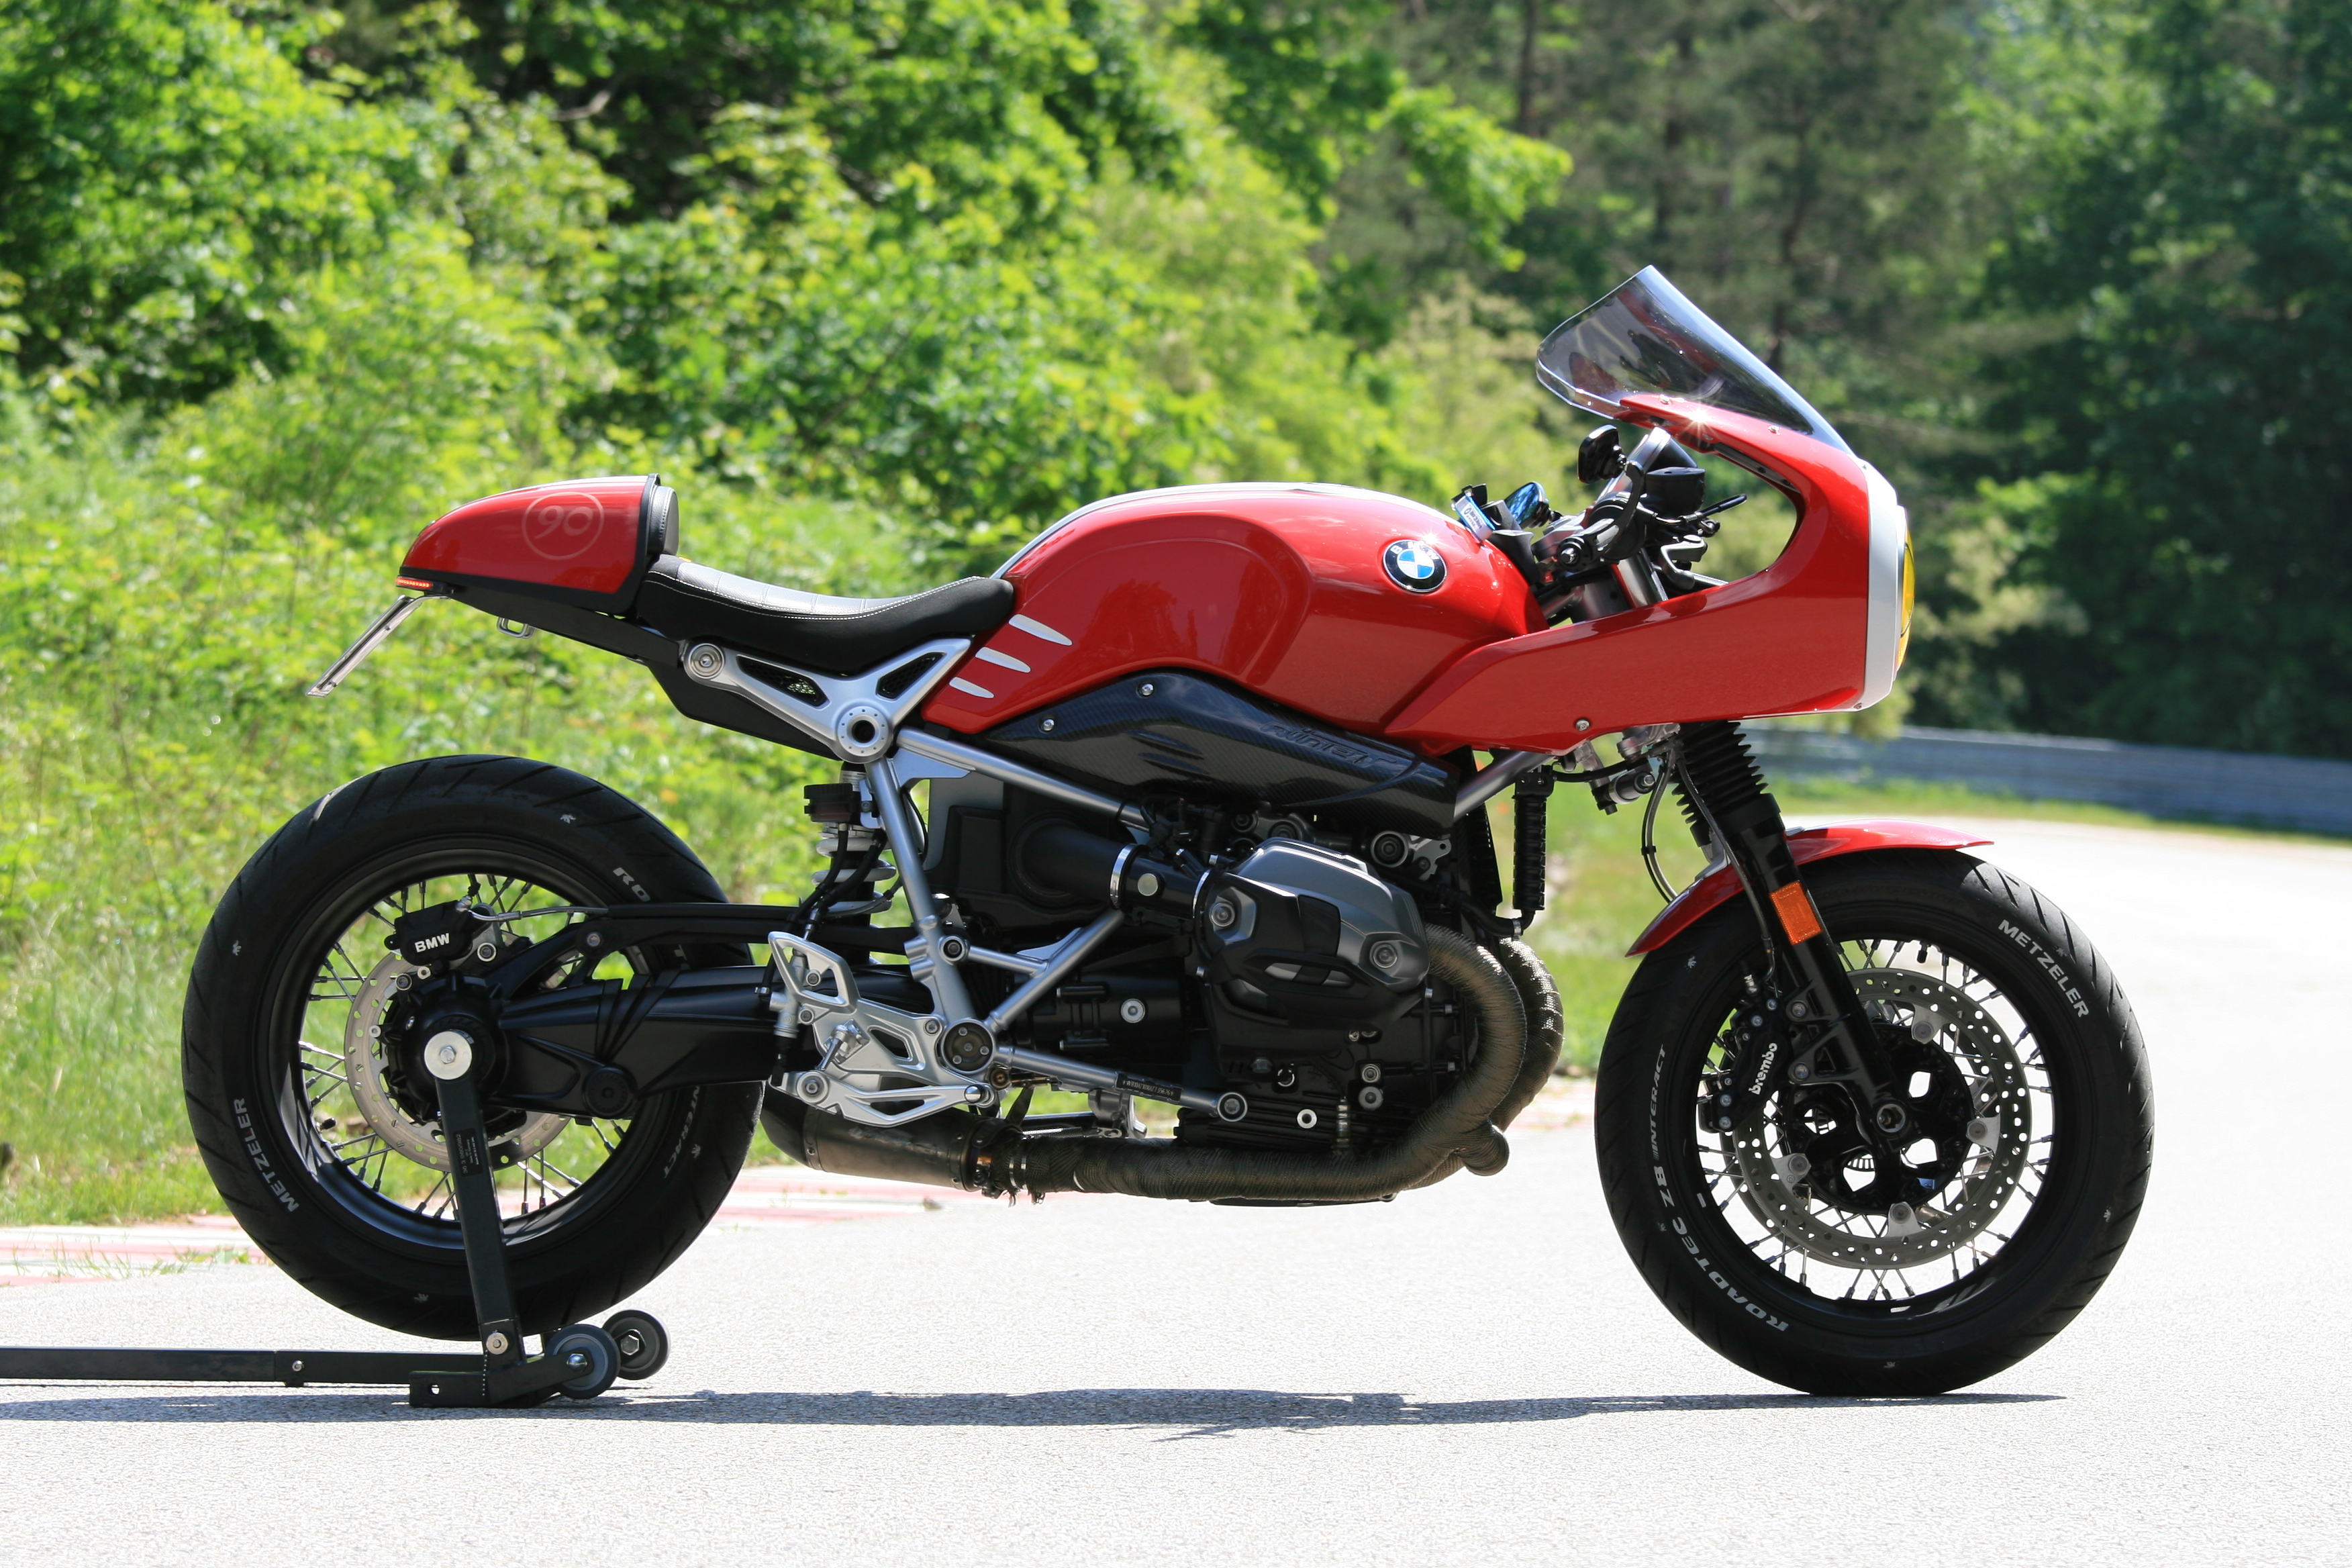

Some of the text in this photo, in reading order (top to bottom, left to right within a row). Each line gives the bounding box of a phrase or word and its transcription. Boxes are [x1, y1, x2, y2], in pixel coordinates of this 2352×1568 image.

[534, 505, 593, 539] 90
[414, 932, 450, 952] BMW
[1998, 919, 2090, 1018] METZELER
[1748, 1042, 1778, 1095] brembo
[234, 1097, 299, 1212] METZELER
[664, 1085, 700, 1179] NTERACT
[1650, 1044, 1789, 1332] ROADTEC Z8 INTERACT
